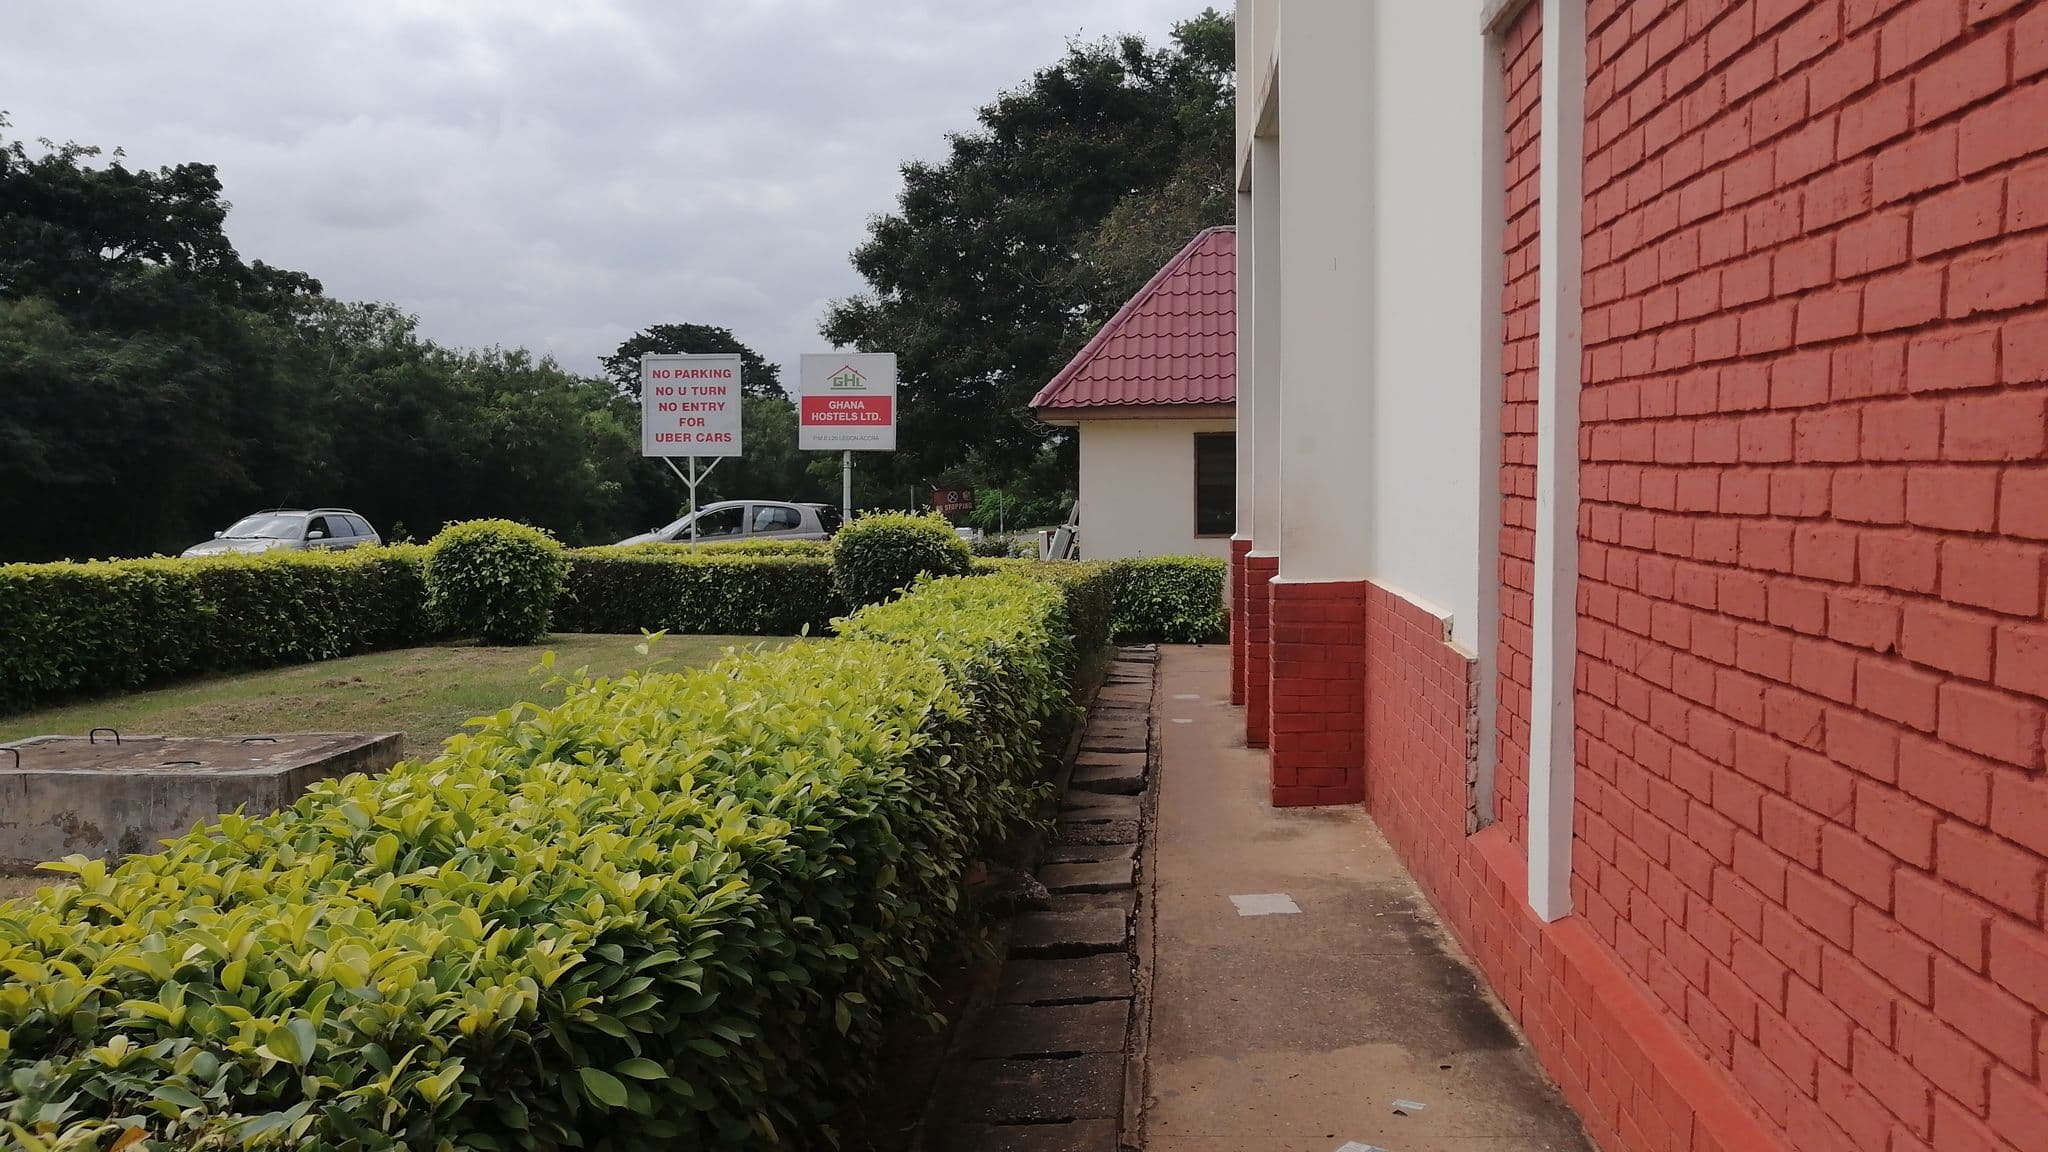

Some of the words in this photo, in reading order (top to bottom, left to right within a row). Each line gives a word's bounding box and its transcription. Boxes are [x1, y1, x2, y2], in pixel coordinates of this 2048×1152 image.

[652, 369, 671, 379] NO
[674, 369, 732, 379] PARKING
[833, 373, 864, 387] GHL
[655, 386, 674, 396] NO
[678, 387, 687, 396] U
[691, 386, 727, 396] TURN
[658, 402, 678, 412] NO
[682, 402, 726, 412] ENTRY
[828, 401, 865, 410] GHANA
[811, 412, 858, 421] HOSTELS
[860, 412, 882, 421] LTD.
[679, 417, 705, 427] FOR
[655, 433, 692, 443] UBER
[695, 433, 732, 443] CARS
